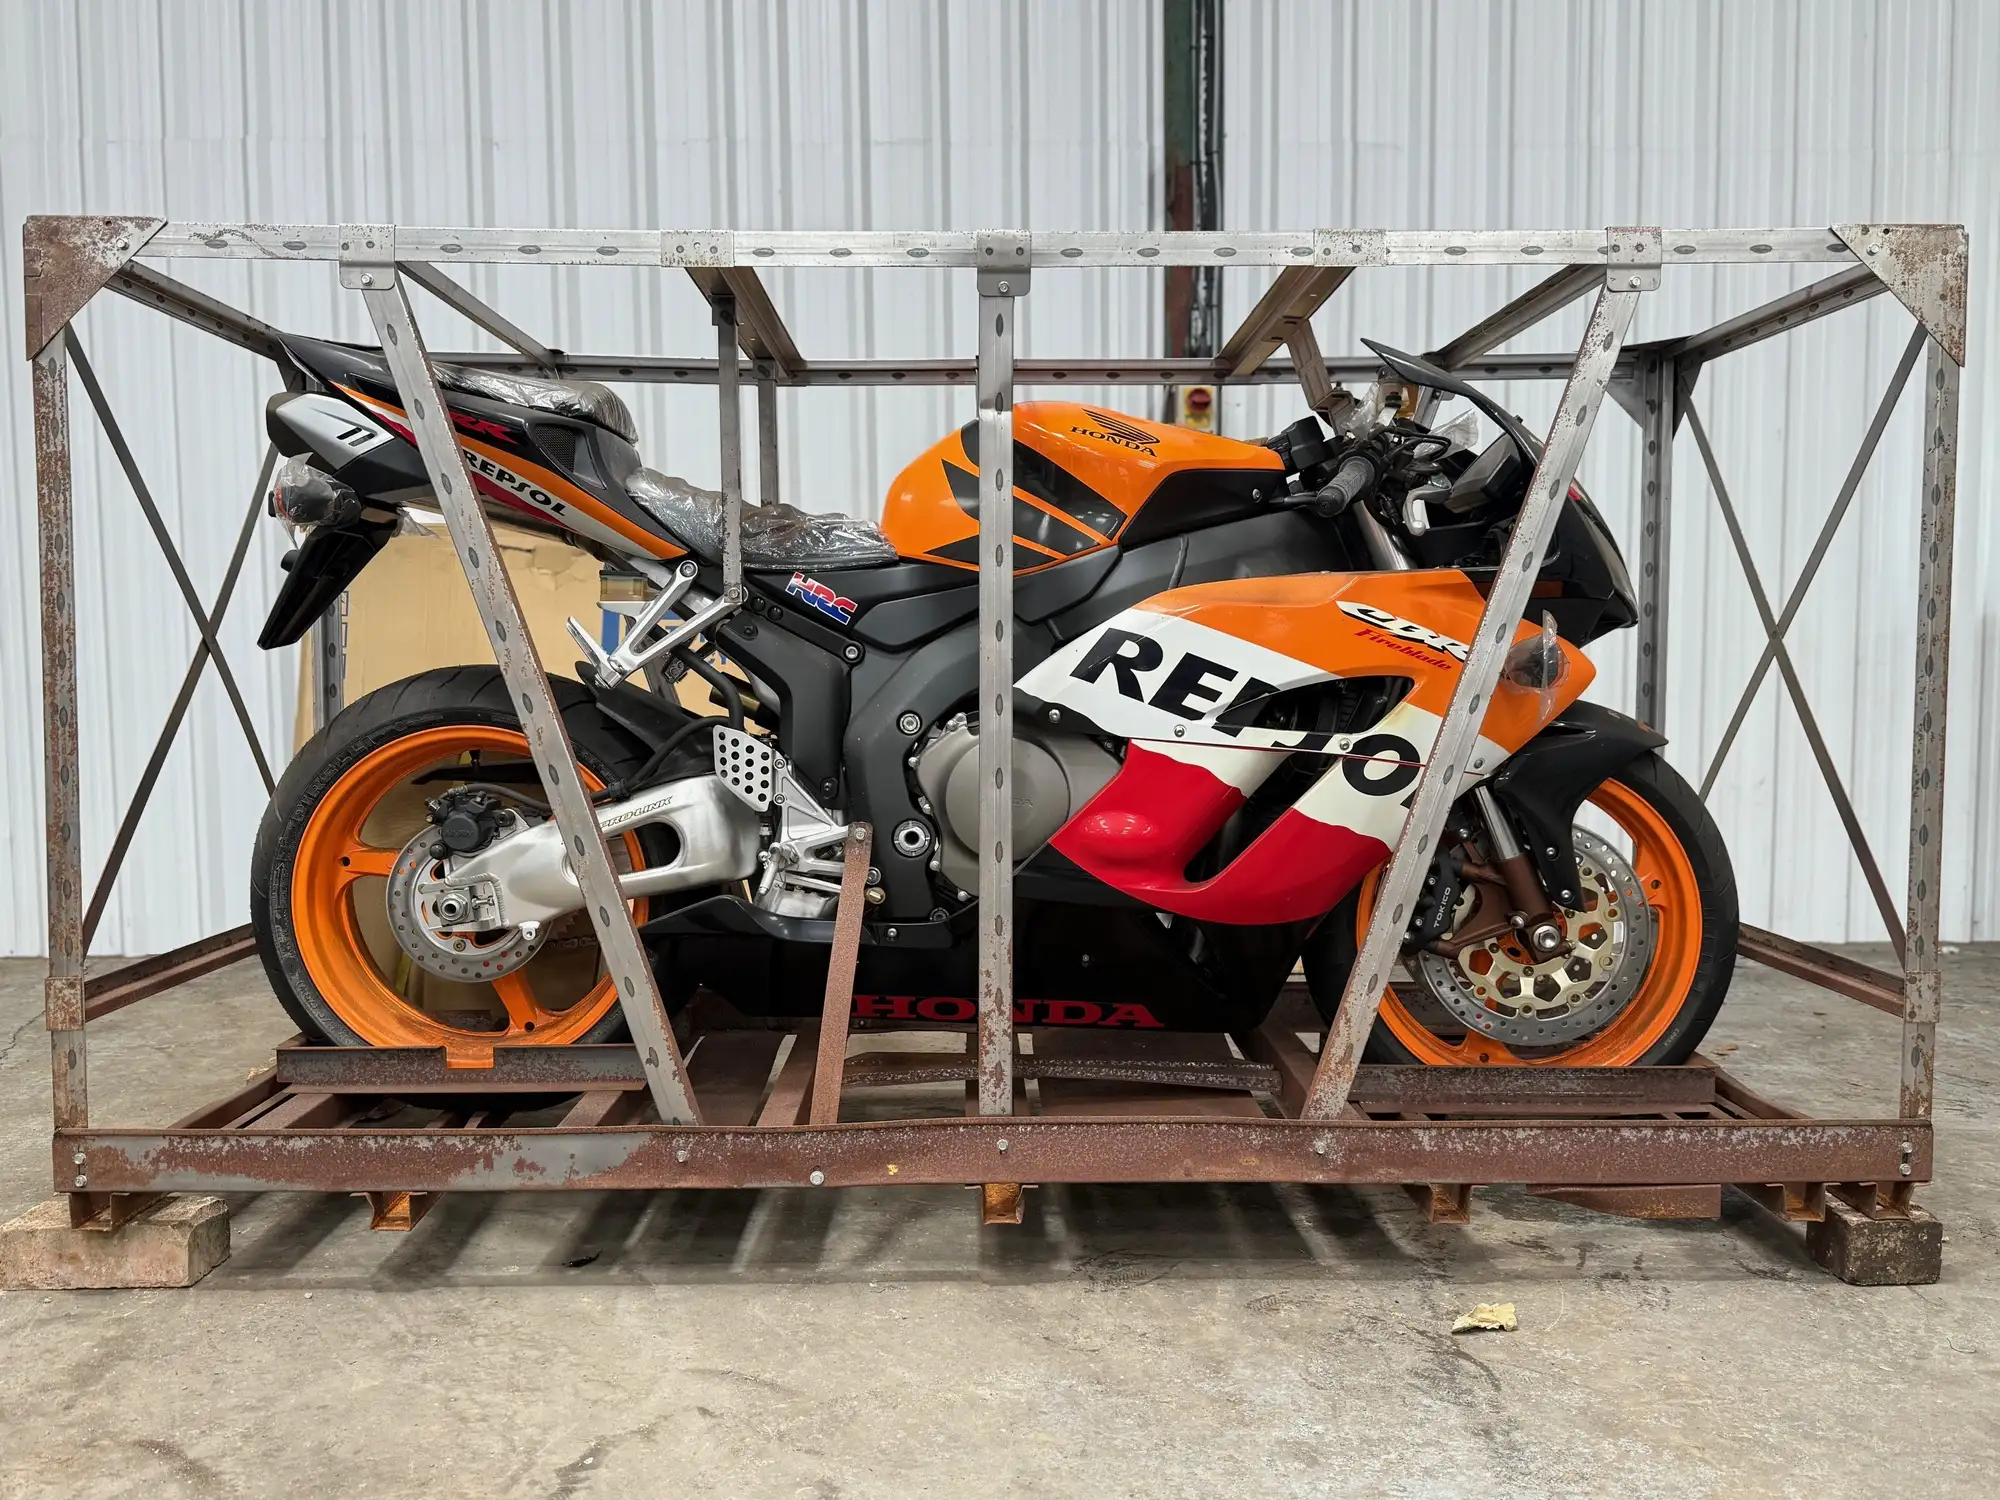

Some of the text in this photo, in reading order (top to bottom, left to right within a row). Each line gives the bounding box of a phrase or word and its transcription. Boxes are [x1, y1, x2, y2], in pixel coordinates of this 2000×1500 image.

[1070, 425, 1158, 458] HONDA
[463, 448, 569, 517] REPSOL
[785, 571, 859, 626] HRC
[1353, 628, 1452, 671] Fireblade
[1433, 886, 1452, 928] TOKICO
